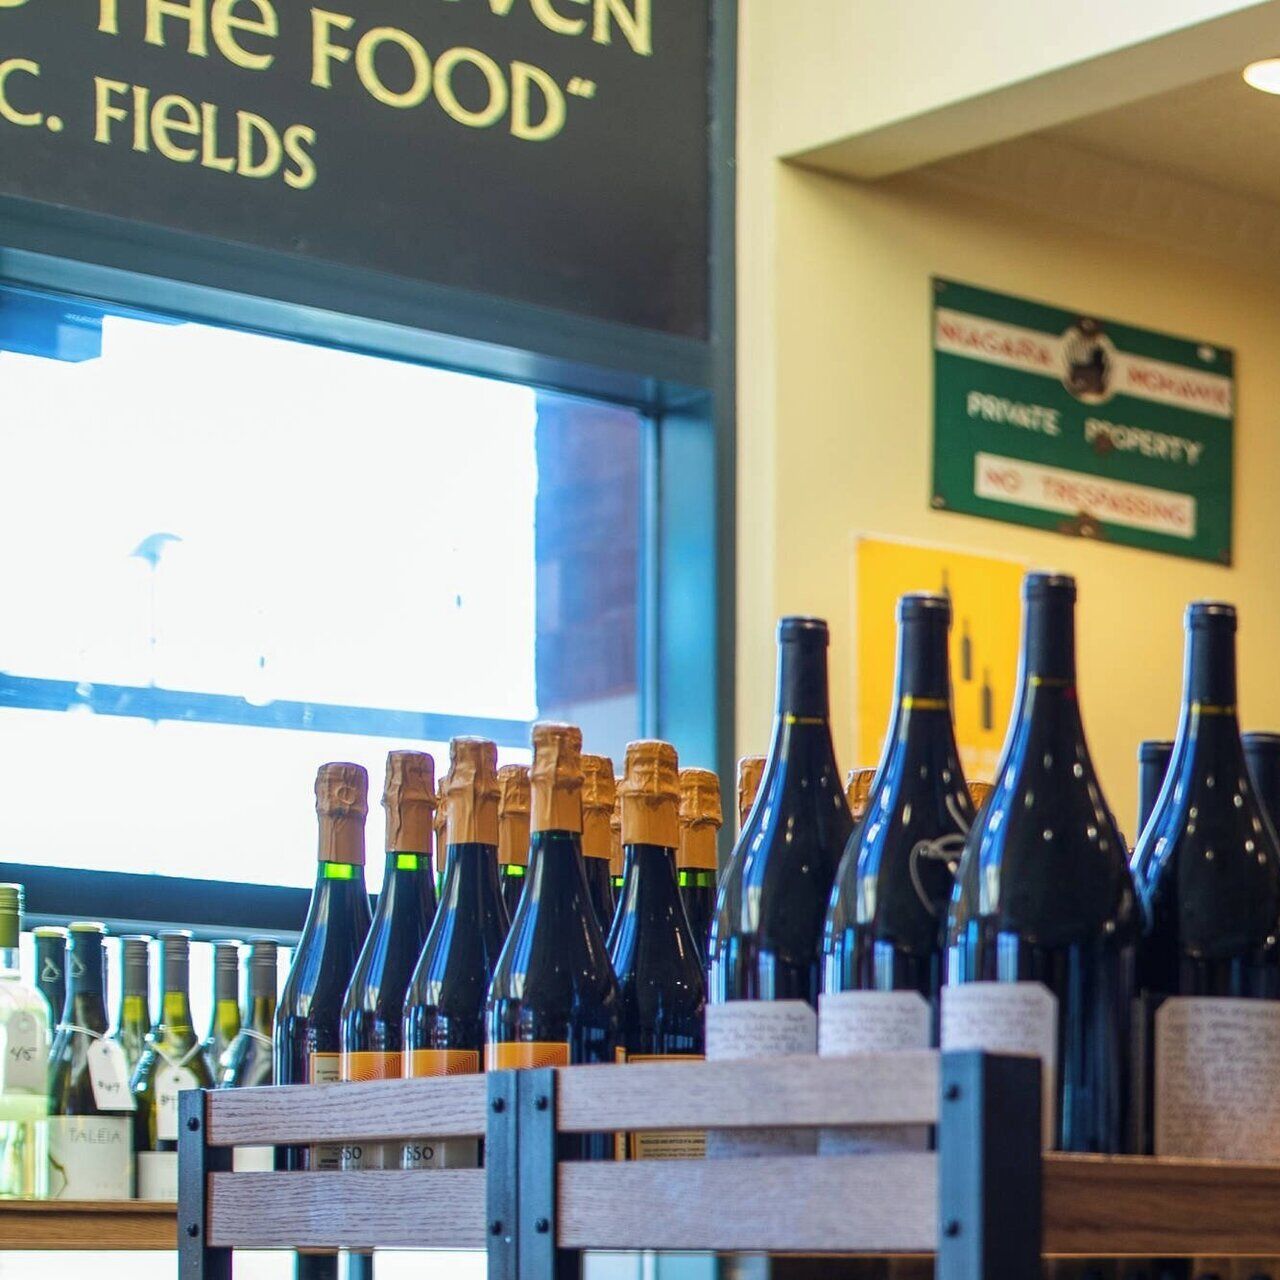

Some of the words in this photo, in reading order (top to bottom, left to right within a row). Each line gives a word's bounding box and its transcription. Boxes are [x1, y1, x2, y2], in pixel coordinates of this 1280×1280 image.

[966, 390, 1062, 436] PRIVATE
[1084, 417, 1204, 466] PROPERTY
[984, 464, 1023, 495] NO
